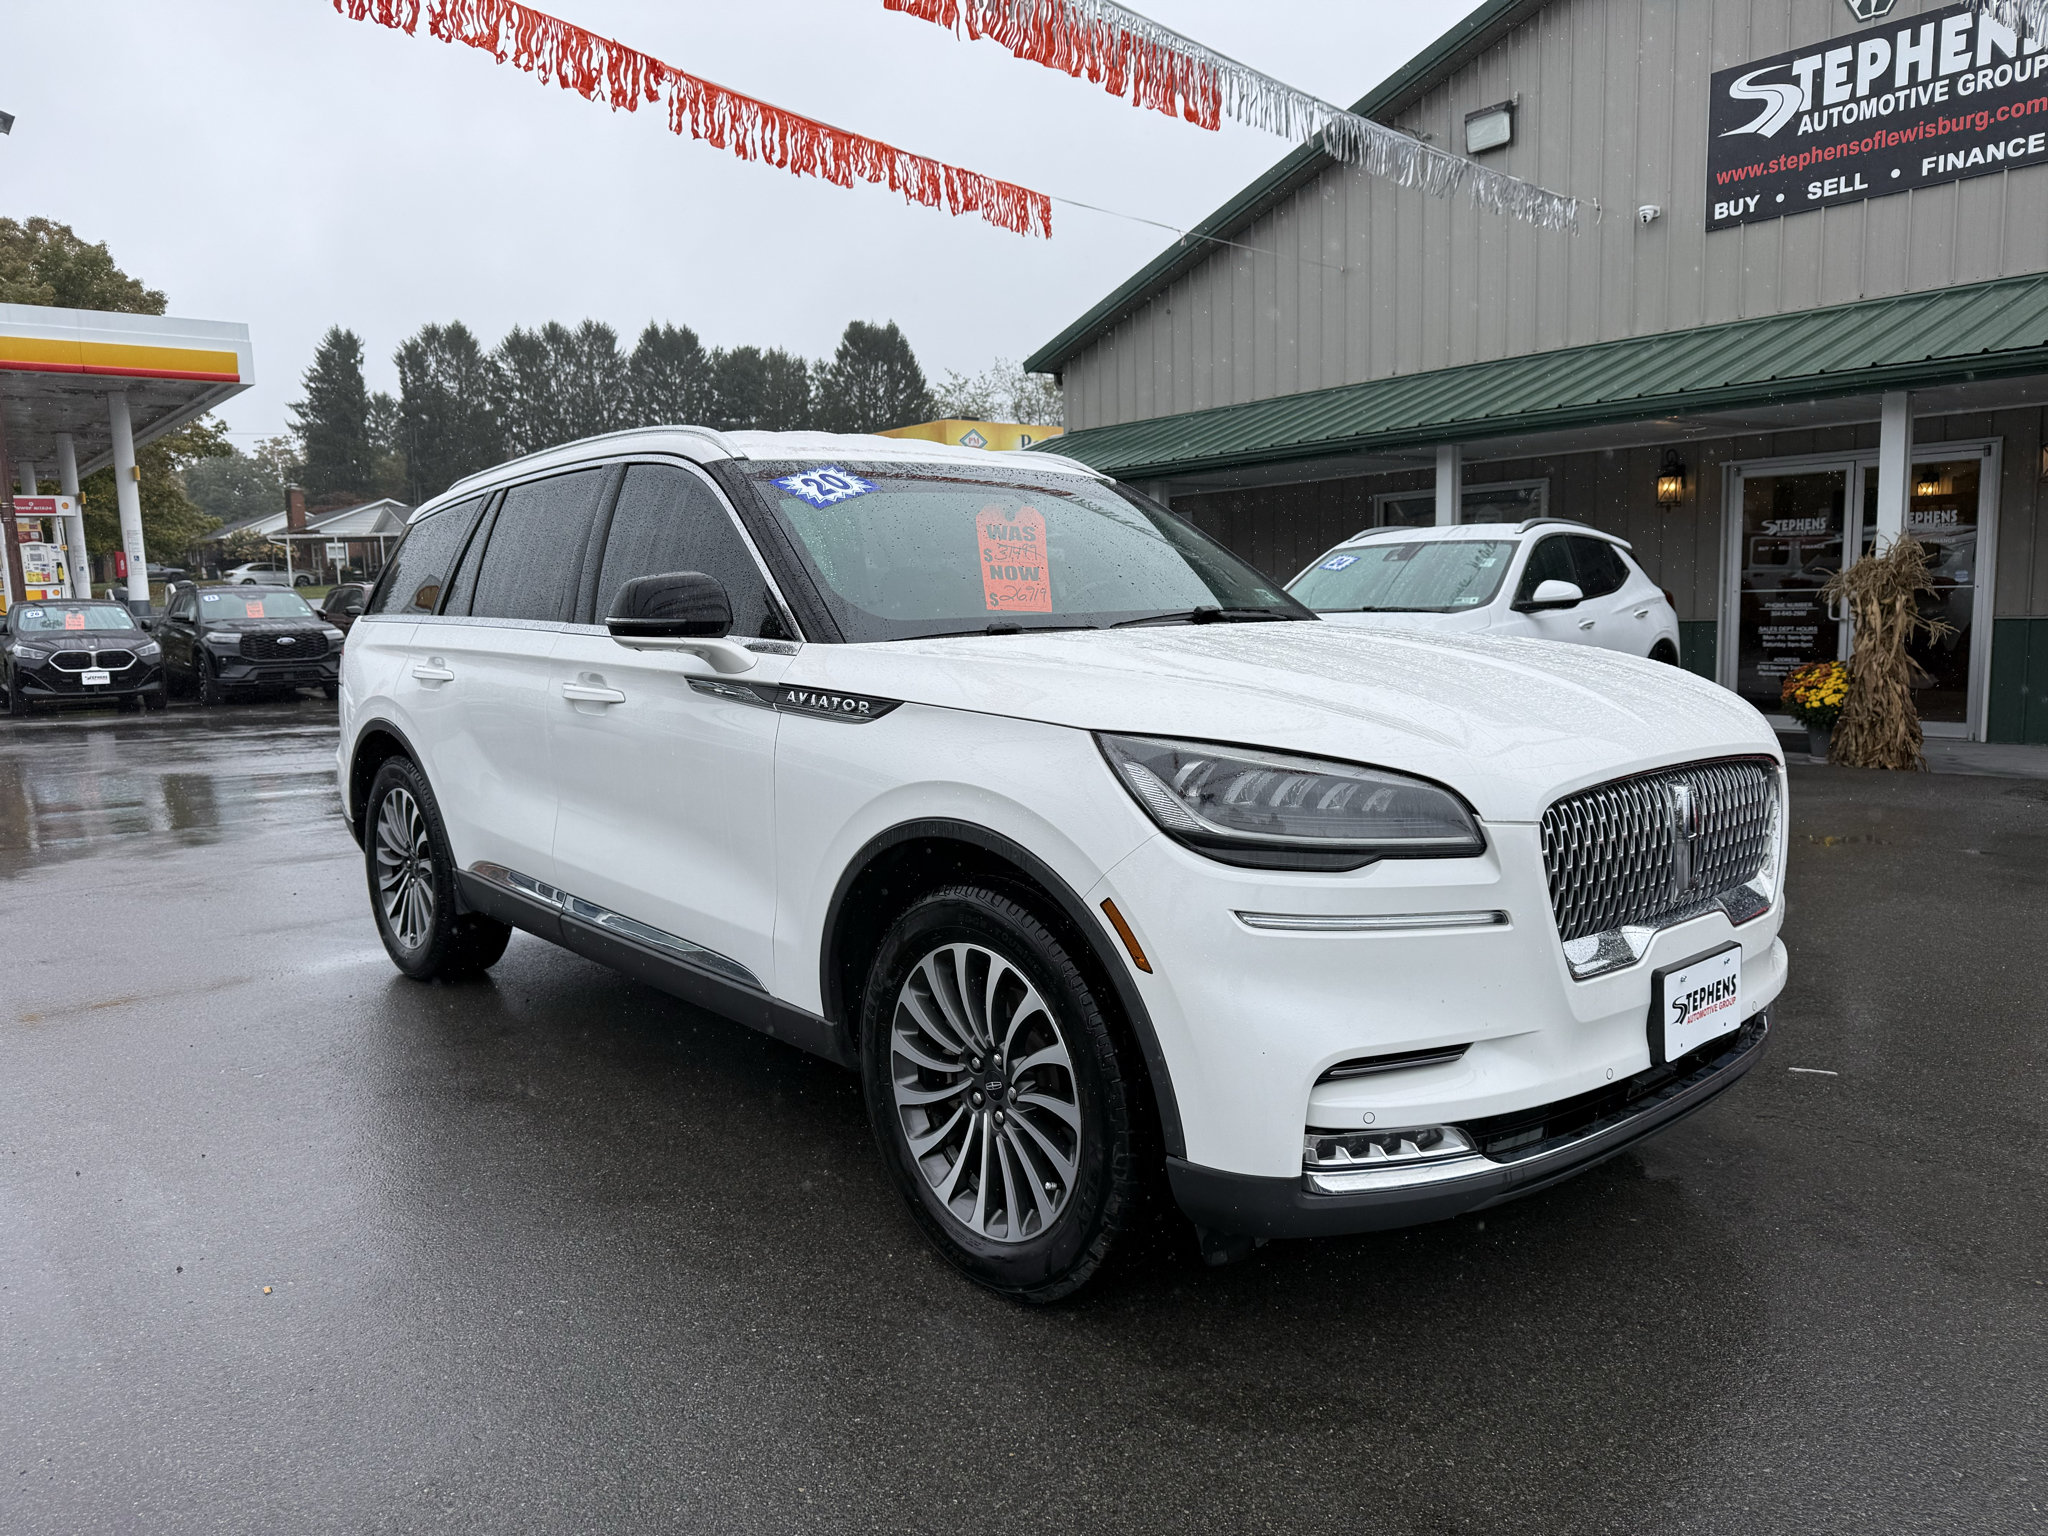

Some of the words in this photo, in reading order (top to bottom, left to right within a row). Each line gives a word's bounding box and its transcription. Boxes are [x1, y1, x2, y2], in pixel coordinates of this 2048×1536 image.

[1718, 8, 2046, 139] STEPHEN
[1797, 79, 1950, 136] AUTOMOTIVE
[1957, 53, 2048, 97] GROUP
[1715, 96, 2048, 185] www.stephensoflewisburg.com
[1714, 194, 1761, 220] BUY
[1807, 172, 1869, 200] SELL
[1922, 132, 2046, 177] FINANCE
[800, 473, 851, 496] 20
[985, 525, 1037, 541] WAS
[1761, 517, 1827, 536] STEPHENS
[989, 565, 1040, 581] NOW
[785, 690, 871, 714] AVIATOR
[1671, 973, 1737, 1025] STEPHENS
[1686, 1003, 1718, 1025] AUTOMOTIVE
[1719, 996, 1737, 1011] GROUP
